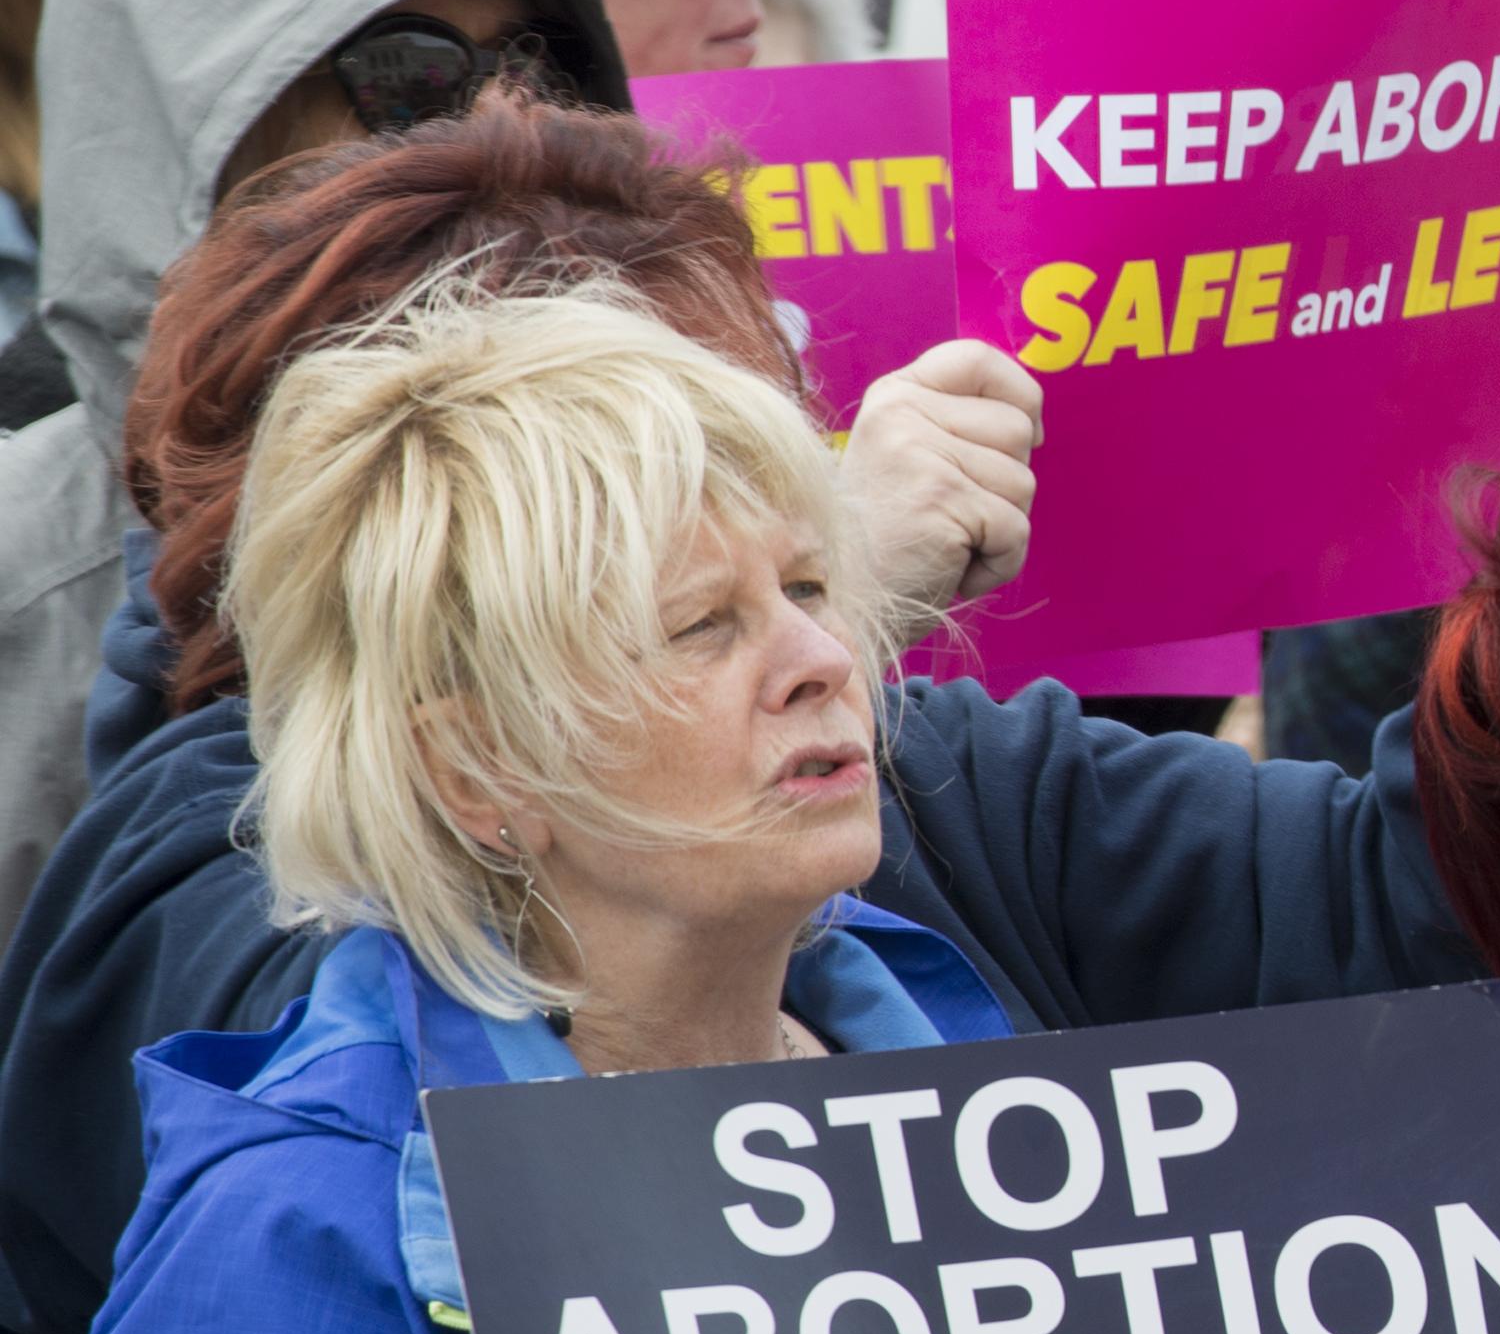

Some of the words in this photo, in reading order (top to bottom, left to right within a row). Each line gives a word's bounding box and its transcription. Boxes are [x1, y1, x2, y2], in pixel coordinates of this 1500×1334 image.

[1009, 87, 1284, 192] KEEP
[1017, 242, 1292, 374] SAFE
[1290, 263, 1389, 340] and
[711, 1060, 1240, 1258] STOP
